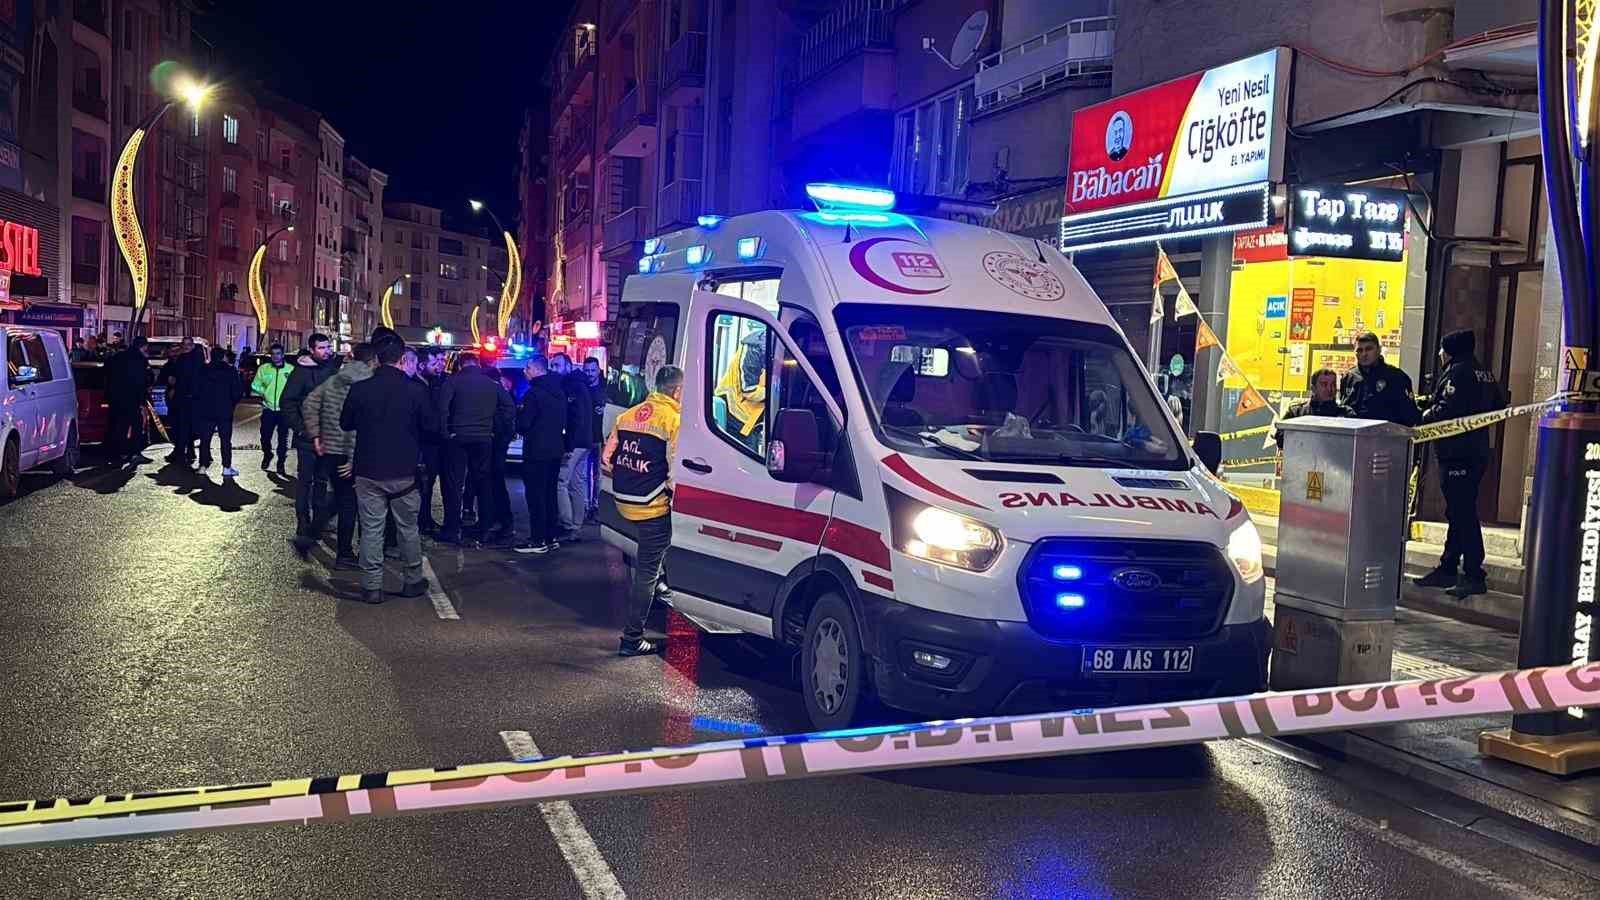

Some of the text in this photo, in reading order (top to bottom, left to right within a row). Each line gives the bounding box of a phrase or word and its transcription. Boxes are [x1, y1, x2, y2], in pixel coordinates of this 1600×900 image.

[1217, 73, 1270, 109] Yeni Nesil
[1187, 106, 1266, 163] Çiğköfte
[1231, 154, 1239, 167] EL
[1300, 190, 1346, 223] Tap
[899, 254, 933, 267] 112
[1094, 649, 1114, 670] 68
[1123, 650, 1153, 670] AAS
[1163, 649, 1191, 669] 112
